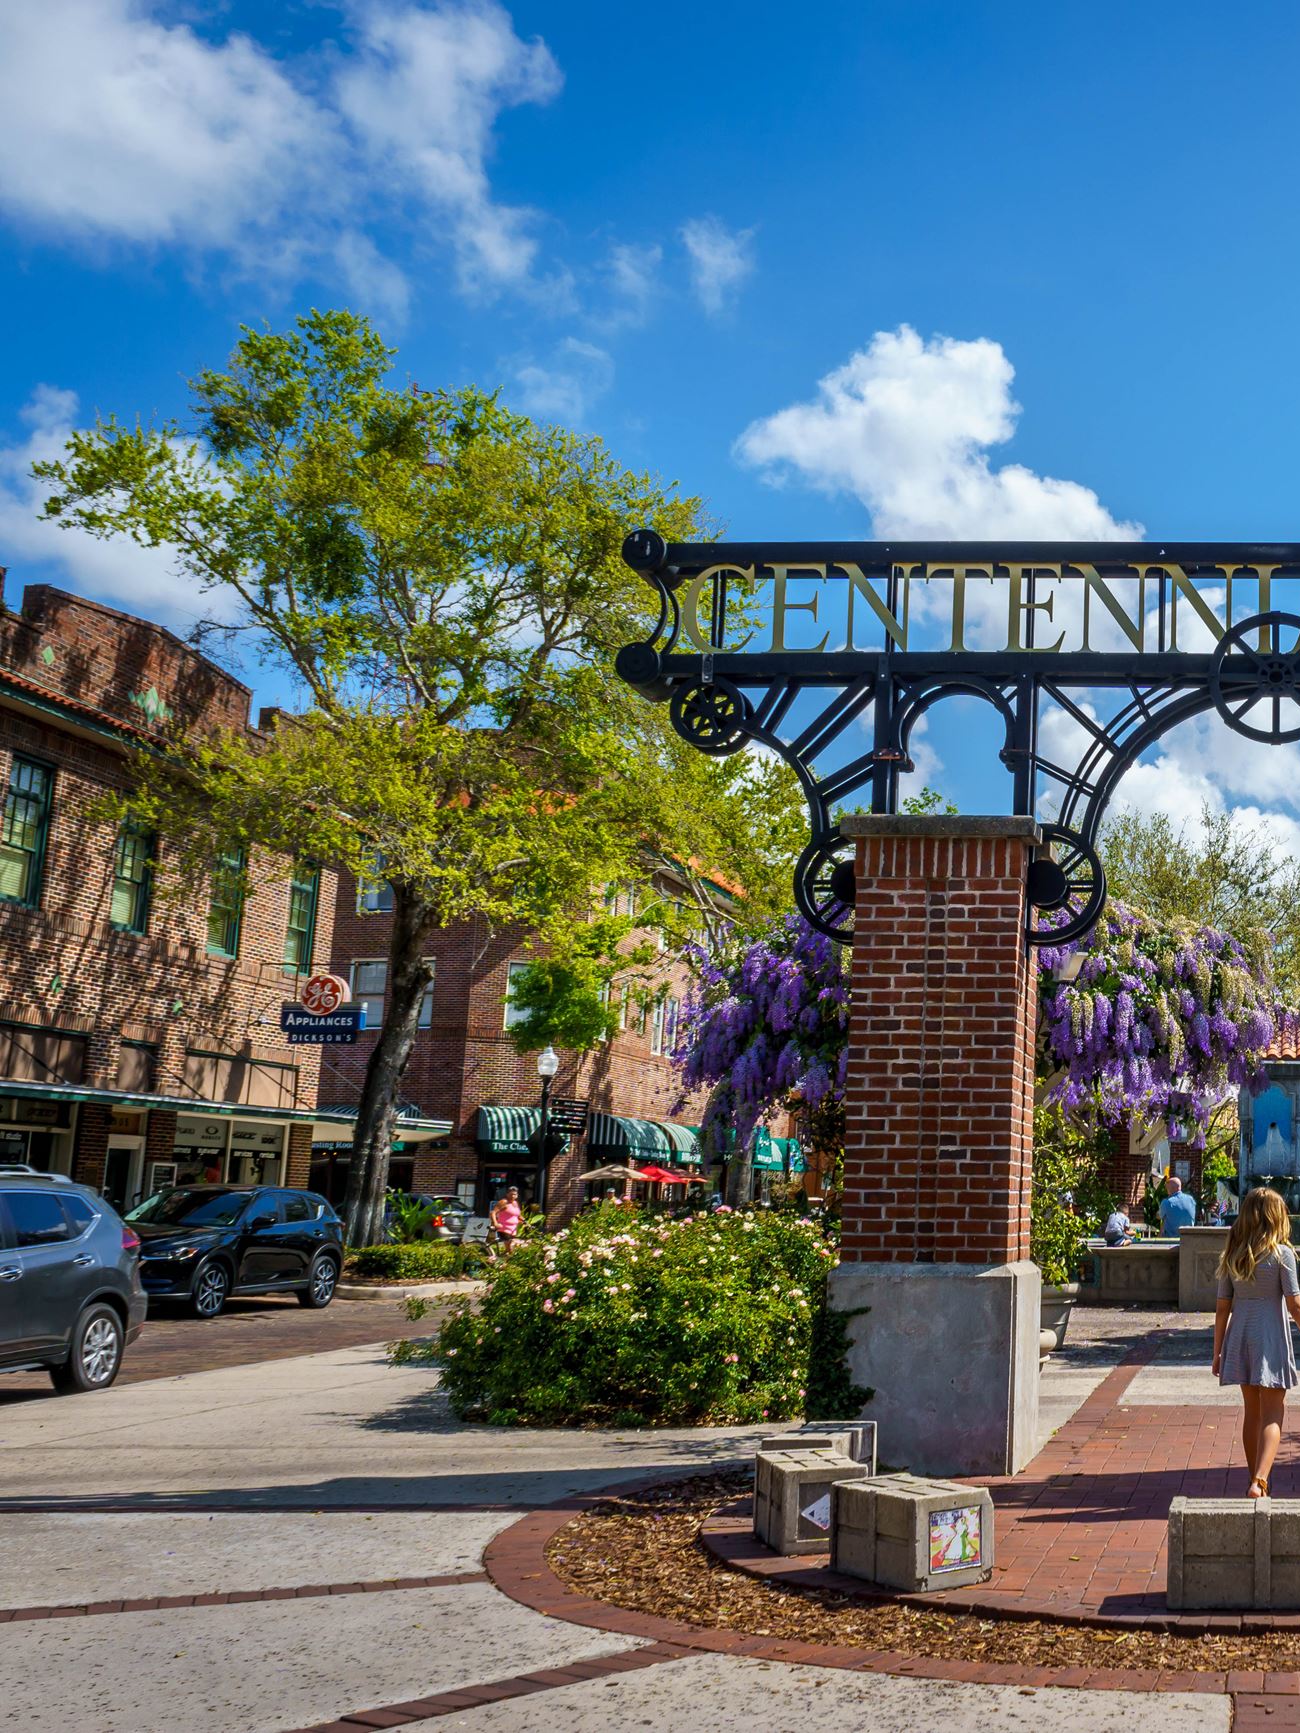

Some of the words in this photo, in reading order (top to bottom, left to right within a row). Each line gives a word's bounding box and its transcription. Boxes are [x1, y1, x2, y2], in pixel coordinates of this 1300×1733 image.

[286, 1013, 353, 1026] APPLIANCES
[292, 1034, 352, 1042] DICKSON'S
[312, 1142, 334, 1150] asting
[492, 1142, 508, 1151] The
